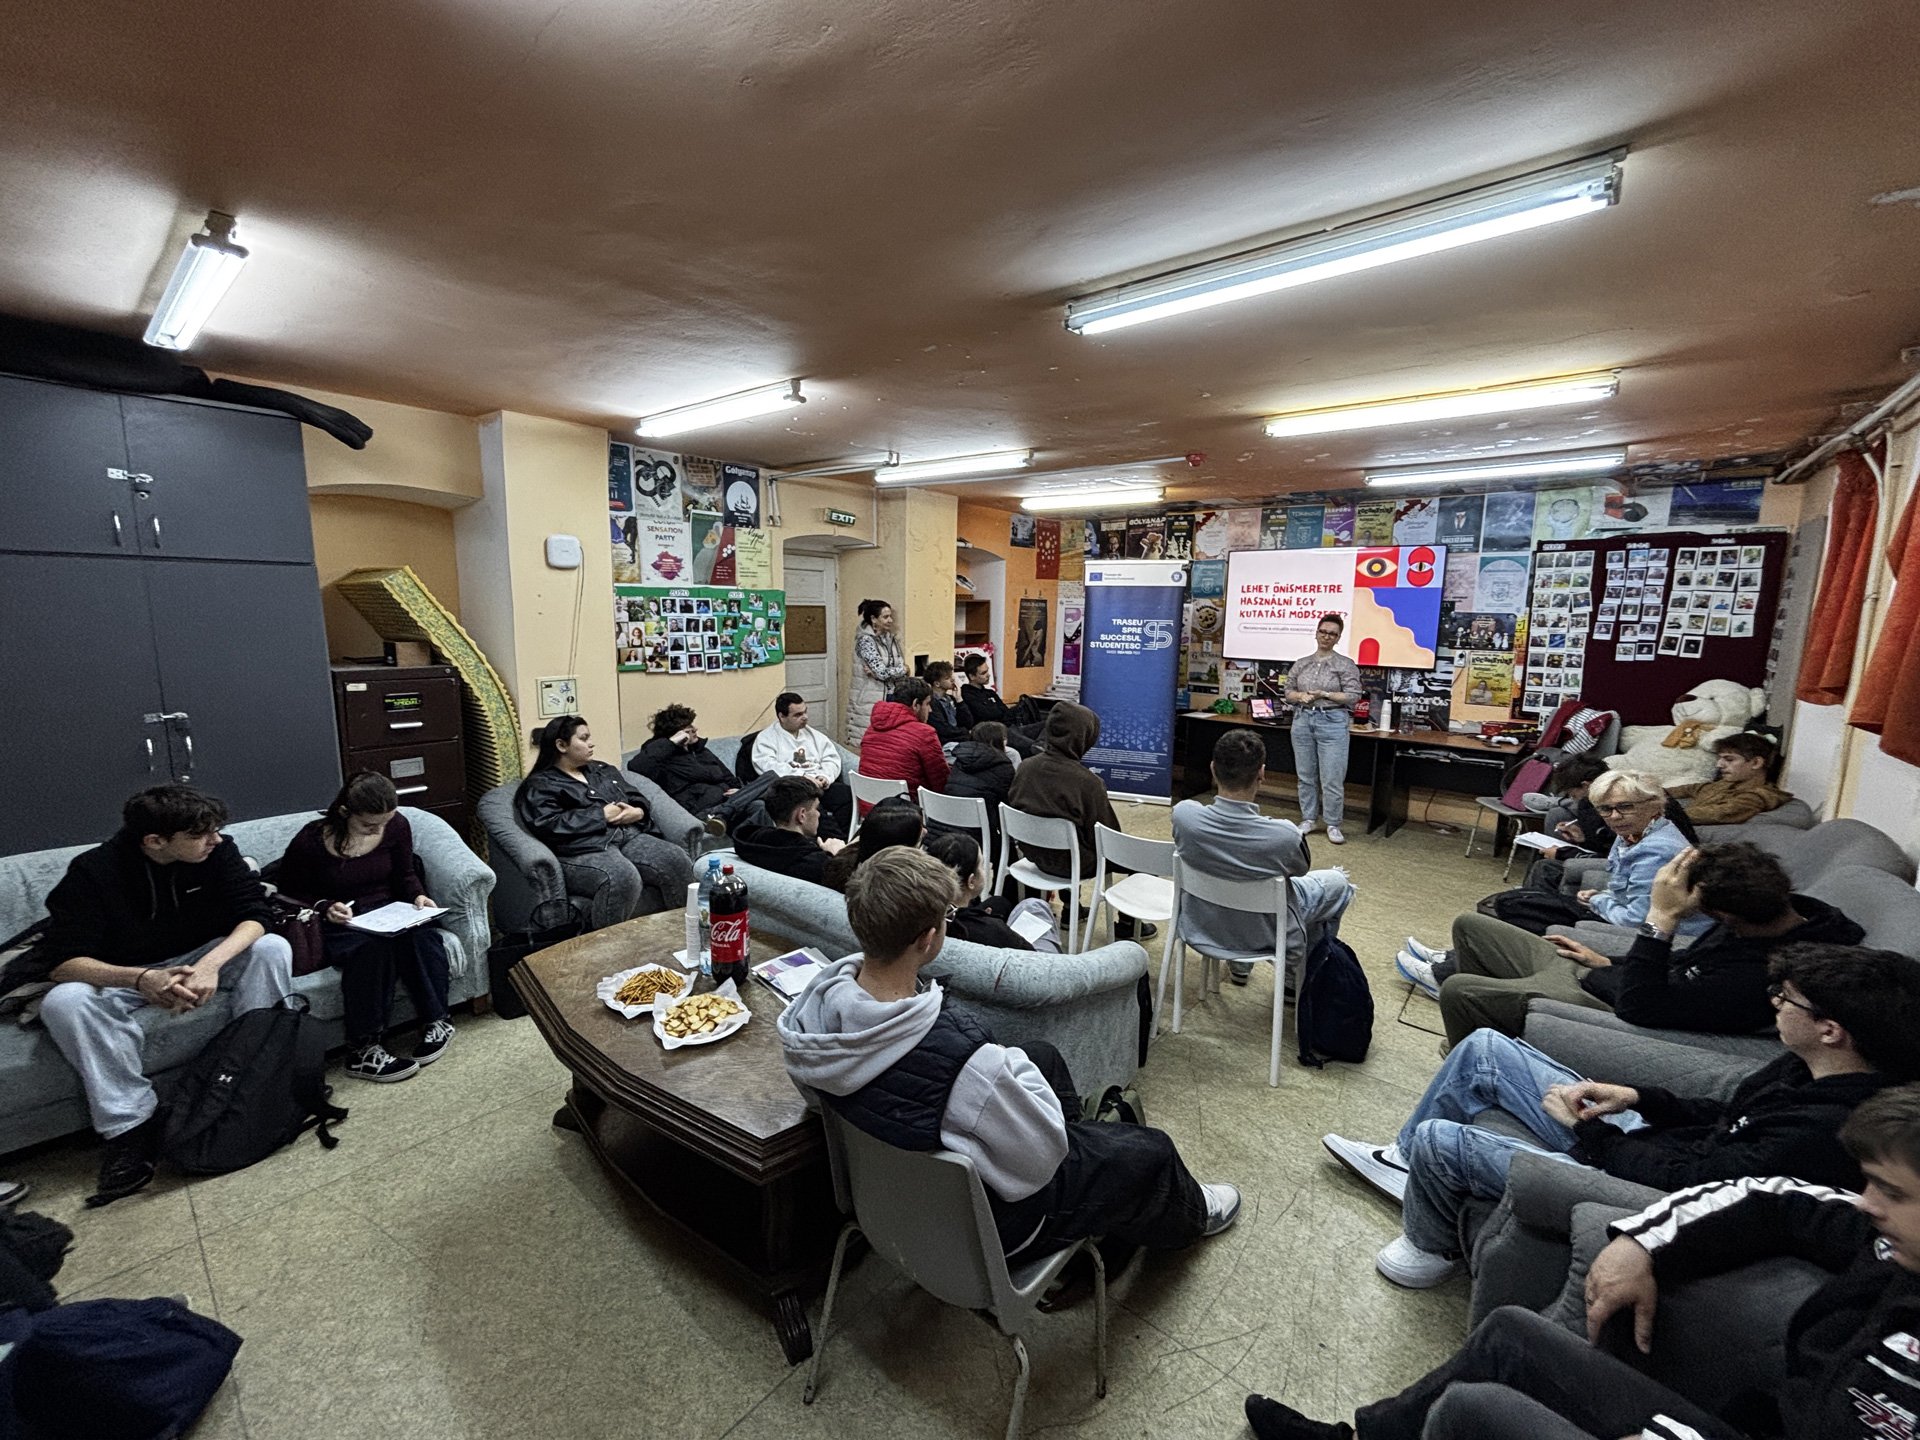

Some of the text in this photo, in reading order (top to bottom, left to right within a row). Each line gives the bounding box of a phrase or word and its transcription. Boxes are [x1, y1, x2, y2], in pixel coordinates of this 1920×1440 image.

[831, 512, 856, 524] EXIT
[647, 525, 683, 534] SENSATION
[655, 534, 676, 542] PARTY
[669, 589, 690, 597] 2020
[1241, 584, 1270, 594] LEHET
[1296, 596, 1317, 607] EGY
[1111, 618, 1143, 626] TRASEU
[1121, 626, 1143, 634] SPRE
[1100, 633, 1142, 642] SUCCESUL
[1089, 641, 1141, 651] STUDENȚESC
[711, 918, 744, 942] Cola
